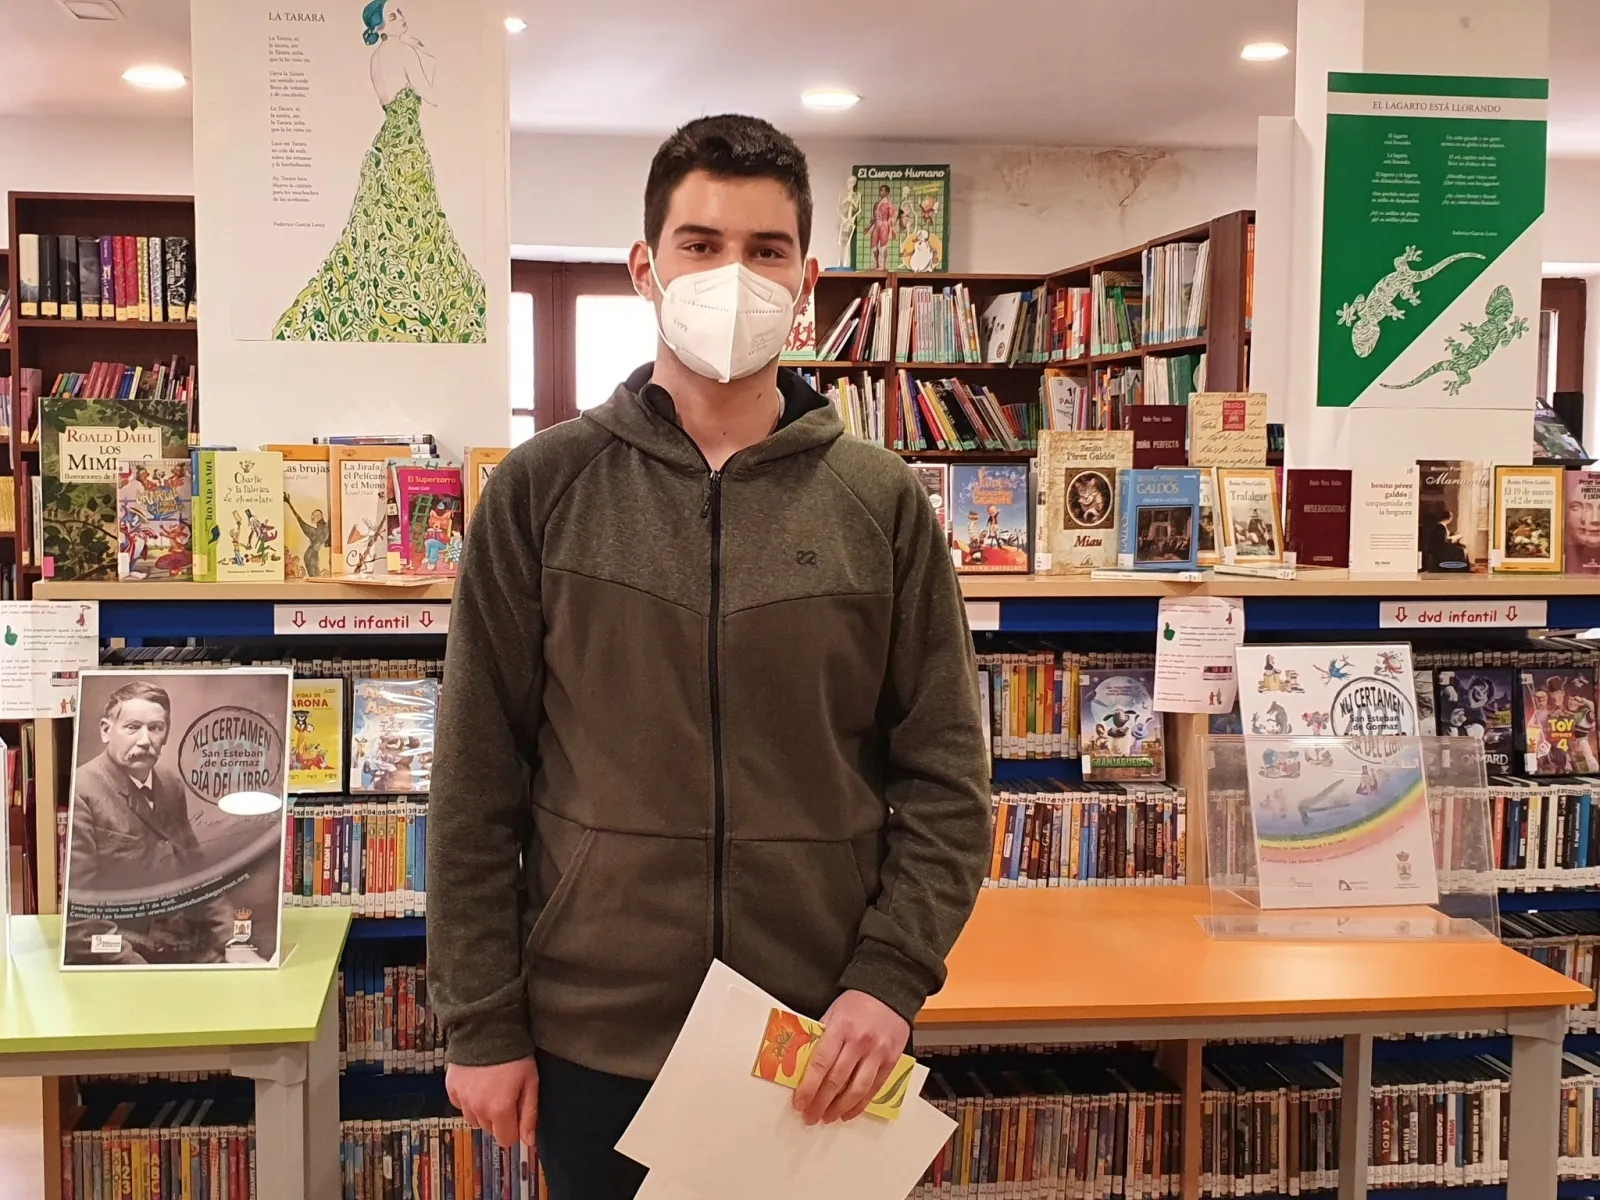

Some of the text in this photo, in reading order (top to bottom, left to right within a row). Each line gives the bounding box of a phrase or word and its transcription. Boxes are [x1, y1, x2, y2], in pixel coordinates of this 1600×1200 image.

[268, 12, 326, 22] LA TARARA
[1372, 101, 1501, 113] EL LAGARTO ESTÁ LLORANDO
[858, 167, 945, 180] El Cuerpo Humano
[67, 429, 156, 443] ROALD DAHL
[1136, 440, 1179, 449] DOÑA PERFECTA
[99, 445, 122, 455] LOS
[299, 463, 330, 475] brujas
[344, 462, 383, 473] La Jirafa,
[234, 472, 263, 485] Charlie
[415, 475, 456, 484] Superzorro
[228, 486, 234, 494] y
[235, 485, 242, 493] la
[351, 480, 358, 489] el
[360, 481, 386, 489] Mono
[1136, 481, 1179, 495] GALDÓS
[1394, 482, 1413, 490] pérez
[1230, 490, 1268, 502] Trafalgar
[1384, 491, 1407, 499] galdós
[1504, 487, 1511, 495] El
[1513, 487, 1521, 495] 19
[1522, 487, 1530, 495] de
[236, 496, 273, 504] chocolate
[1365, 500, 1403, 509] torquemada
[1510, 497, 1517, 505] el
[1523, 497, 1531, 505] de
[1303, 504, 1346, 513] MISERICORDIA
[1386, 508, 1412, 517] hoguera
[1073, 534, 1103, 548] Miau
[1417, 608, 1498, 624] dvd infantil
[318, 615, 409, 629] dvd infantil
[292, 698, 329, 708] ARONA
[1339, 686, 1405, 718] XLI CERTAMEN
[1349, 714, 1400, 723] San Esteban
[1353, 722, 1399, 731] de Gormaz
[1548, 718, 1575, 732] TOY
[192, 717, 272, 753] XLI CERTAMEN
[1557, 738, 1568, 751] 4
[202, 748, 263, 758] San Esteban
[204, 759, 260, 767] de Gormaz
[191, 764, 209, 796] DÍA
[71, 904, 95, 913] Entrega
[151, 902, 160, 910] de
[69, 911, 101, 920] Consulta
[102, 912, 113, 920] las
[114, 911, 134, 919] bases
[1382, 1119, 1390, 1154] CAROL
